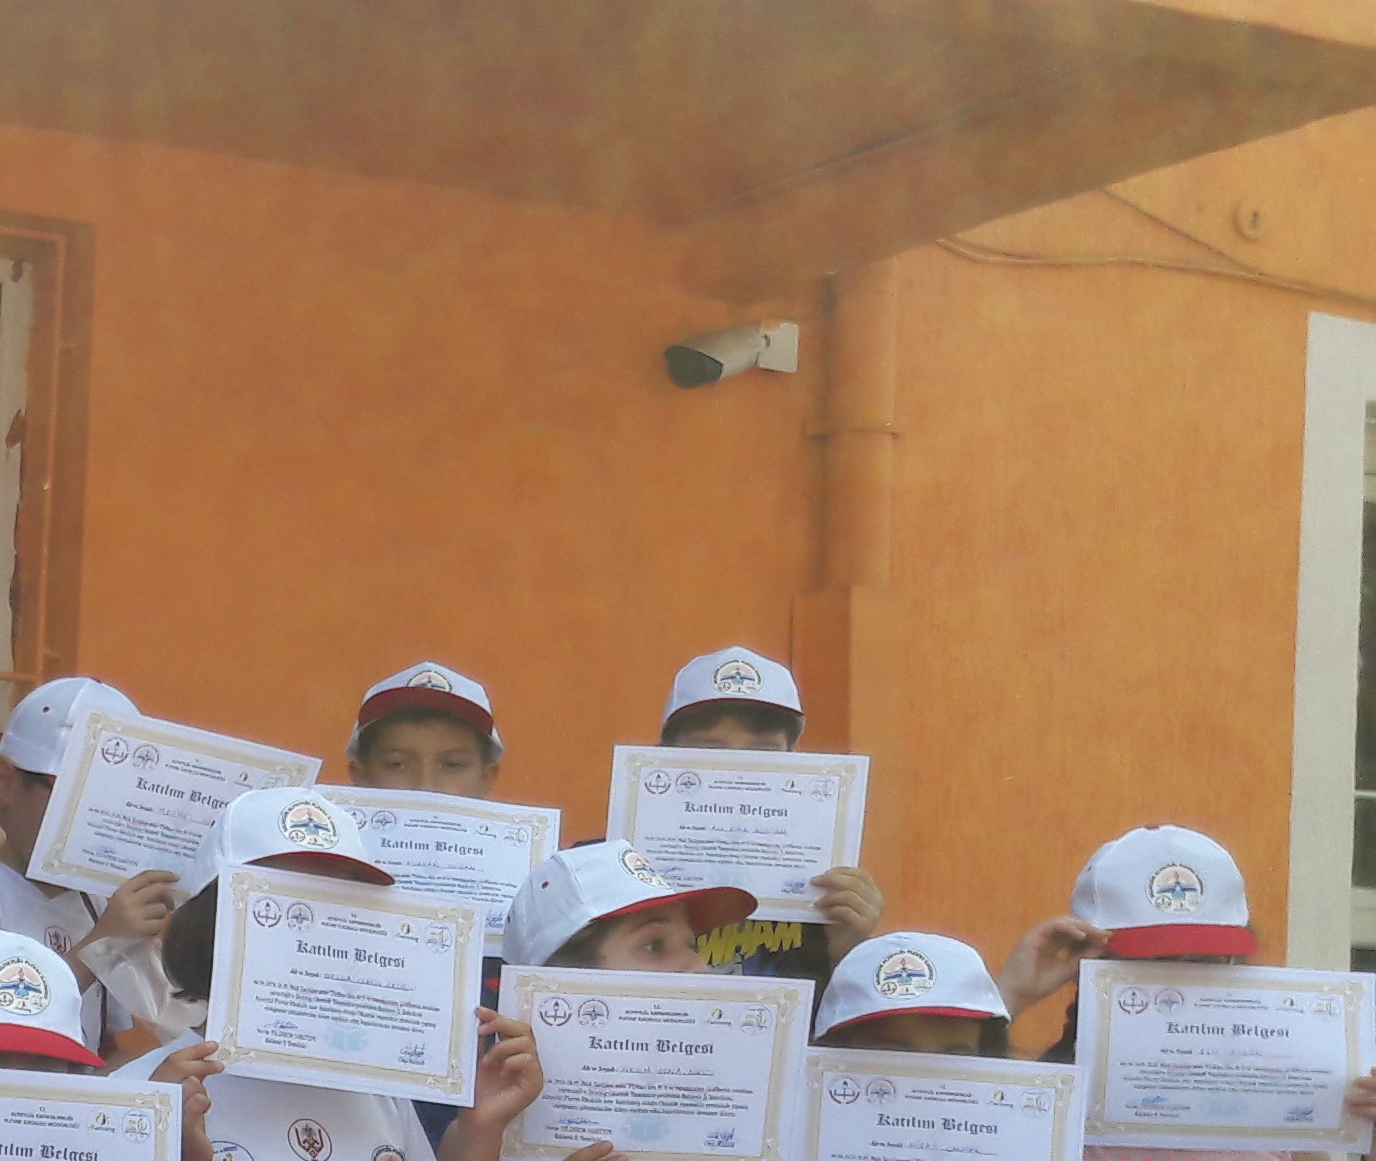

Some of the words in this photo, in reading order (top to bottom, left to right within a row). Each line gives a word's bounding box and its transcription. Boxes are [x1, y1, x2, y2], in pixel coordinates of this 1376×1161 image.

[190, 789, 229, 810] Belge
[295, 939, 348, 960] Katılım
[354, 947, 406, 969] Belgesi
[697, 921, 803, 967] WHAM
[588, 1036, 649, 1052] Katılım
[656, 1039, 714, 1055] Belgesi
[876, 1113, 935, 1129] Katılım
[941, 1117, 998, 1135] Belgesi
